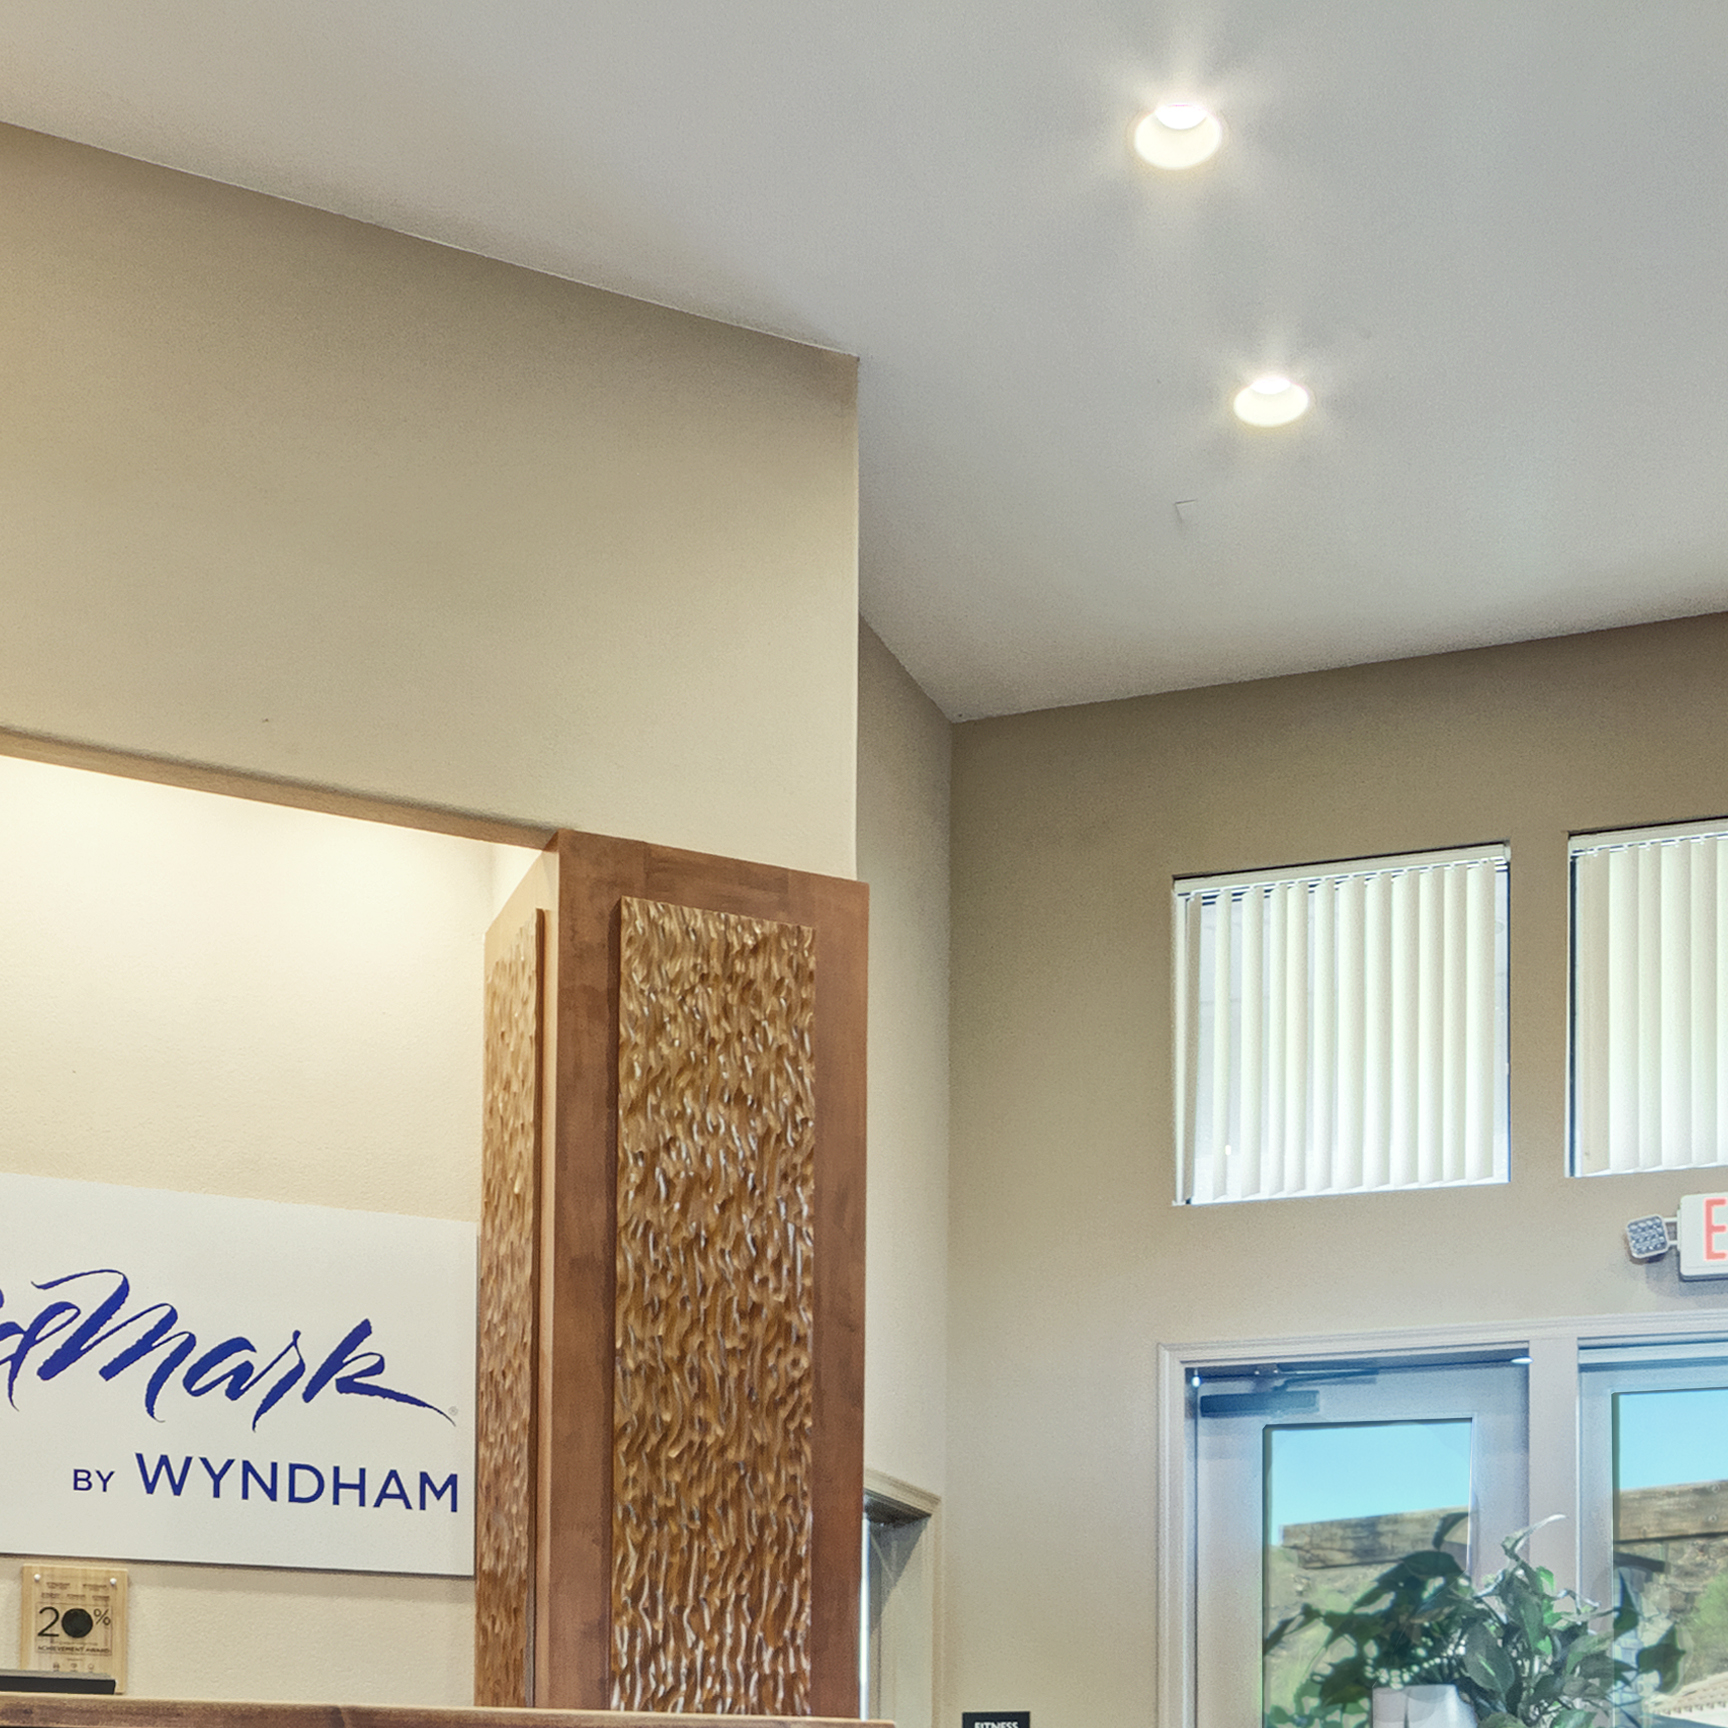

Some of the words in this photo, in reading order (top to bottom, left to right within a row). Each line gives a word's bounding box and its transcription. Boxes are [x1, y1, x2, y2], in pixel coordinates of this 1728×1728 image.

[73, 1468, 116, 1493] BY
[135, 1452, 460, 1514] WYNDHAM
[37, 1645, 85, 1653] ACHIEVEMENT
